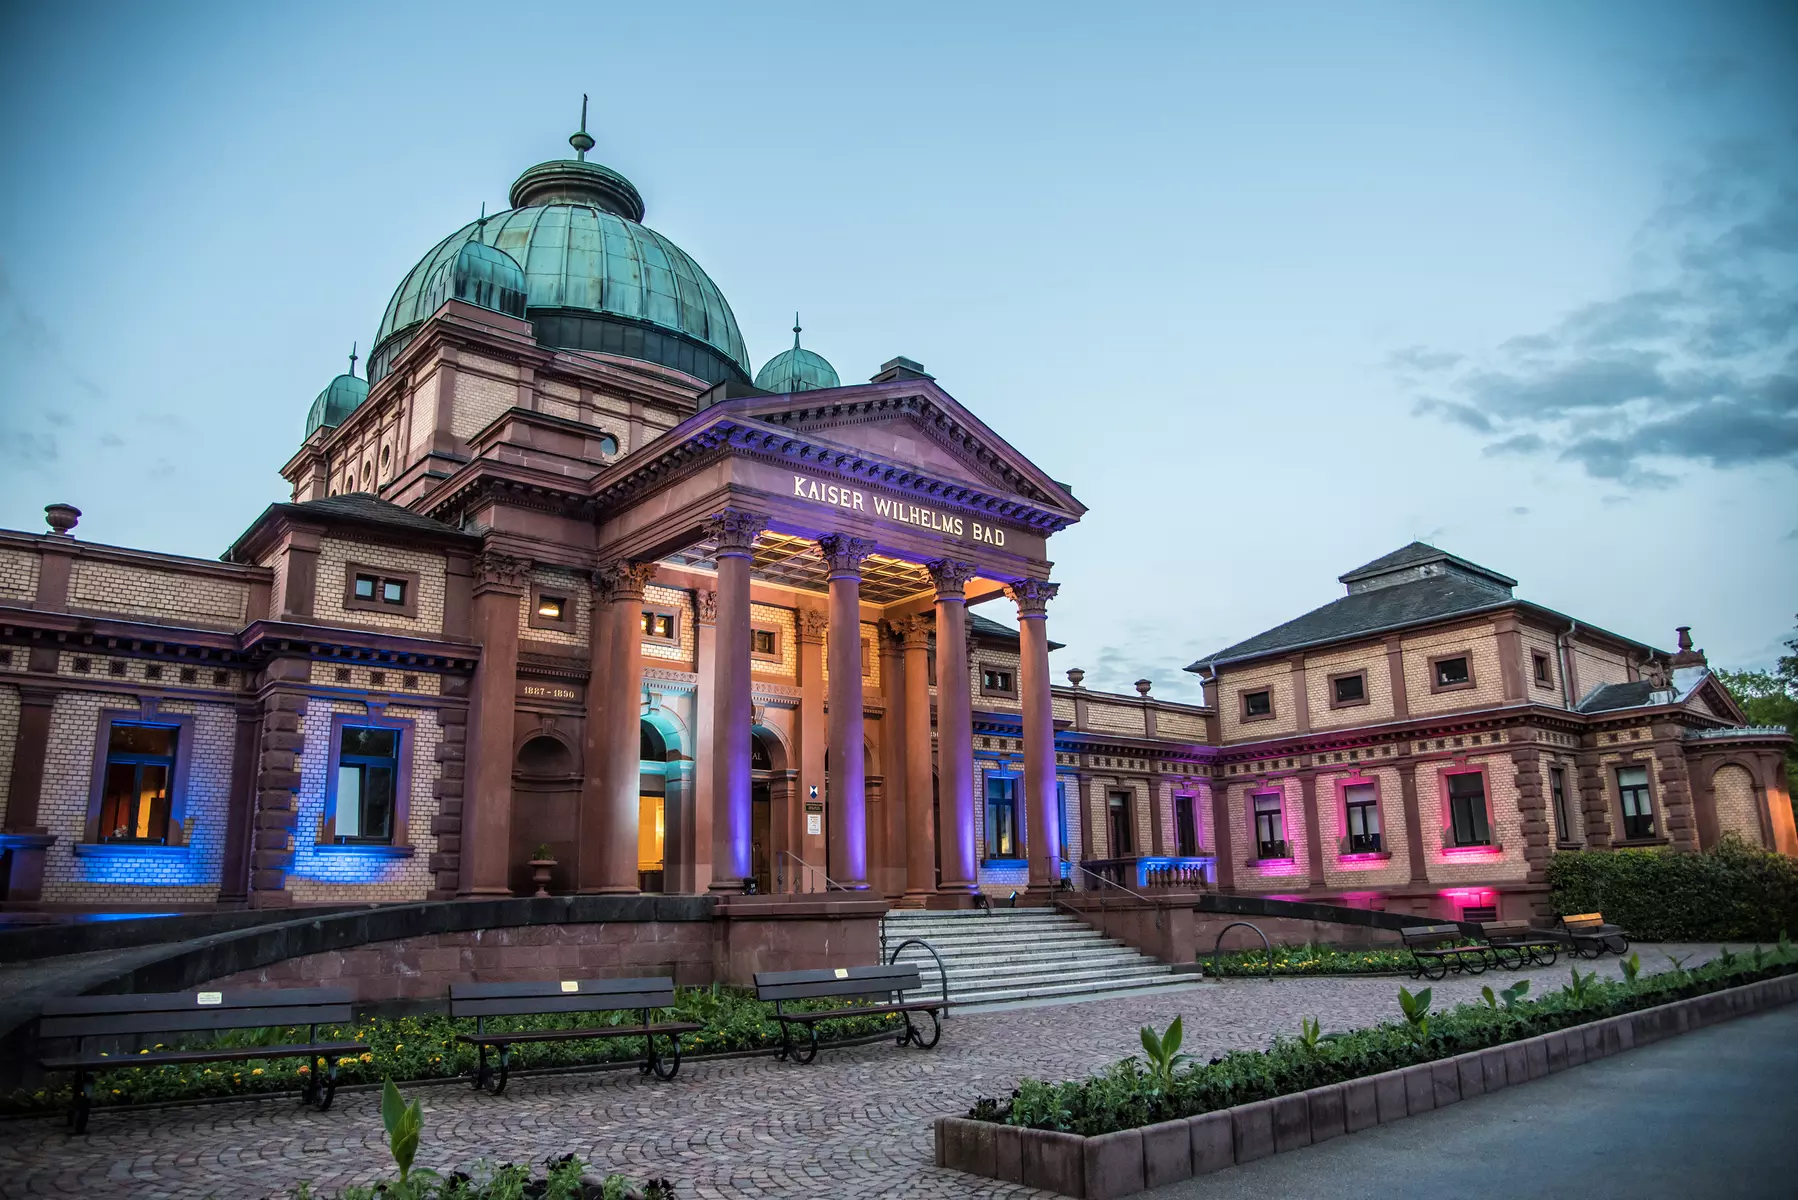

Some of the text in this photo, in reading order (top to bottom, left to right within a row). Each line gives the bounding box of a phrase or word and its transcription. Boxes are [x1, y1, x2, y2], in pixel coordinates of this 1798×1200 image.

[794, 476, 1005, 546] KAISER WILHELMS BAD
